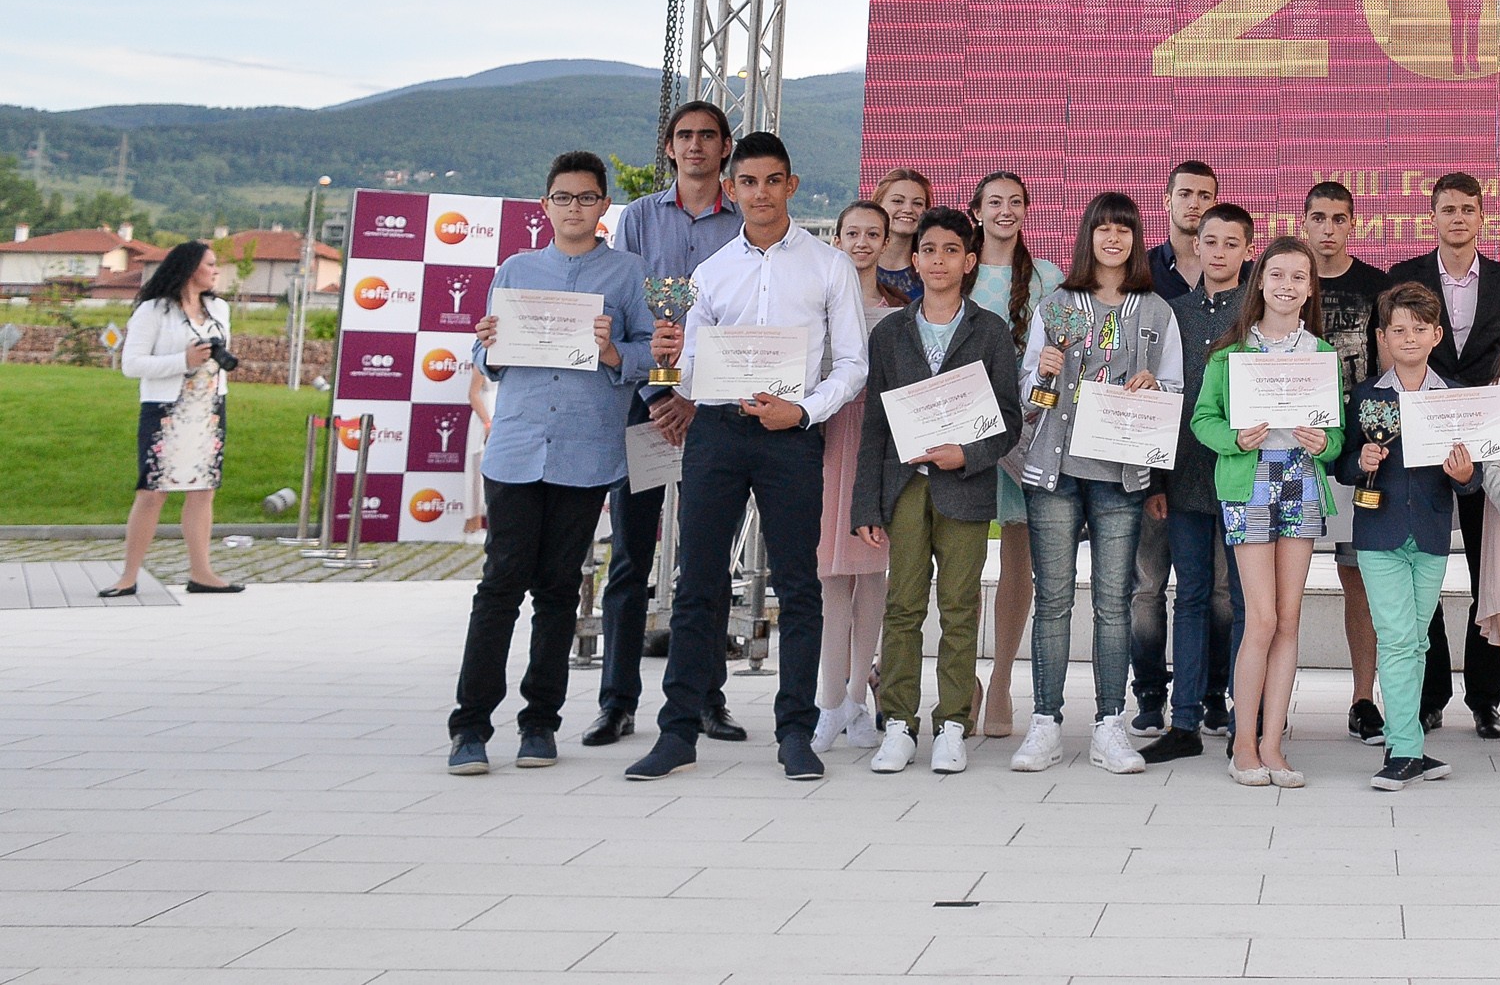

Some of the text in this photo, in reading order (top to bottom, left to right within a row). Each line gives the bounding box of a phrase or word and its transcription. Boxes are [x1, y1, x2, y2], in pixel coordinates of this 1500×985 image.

[470, 223, 494, 238] ring
[391, 287, 416, 302] ring
[378, 427, 402, 442] ring
